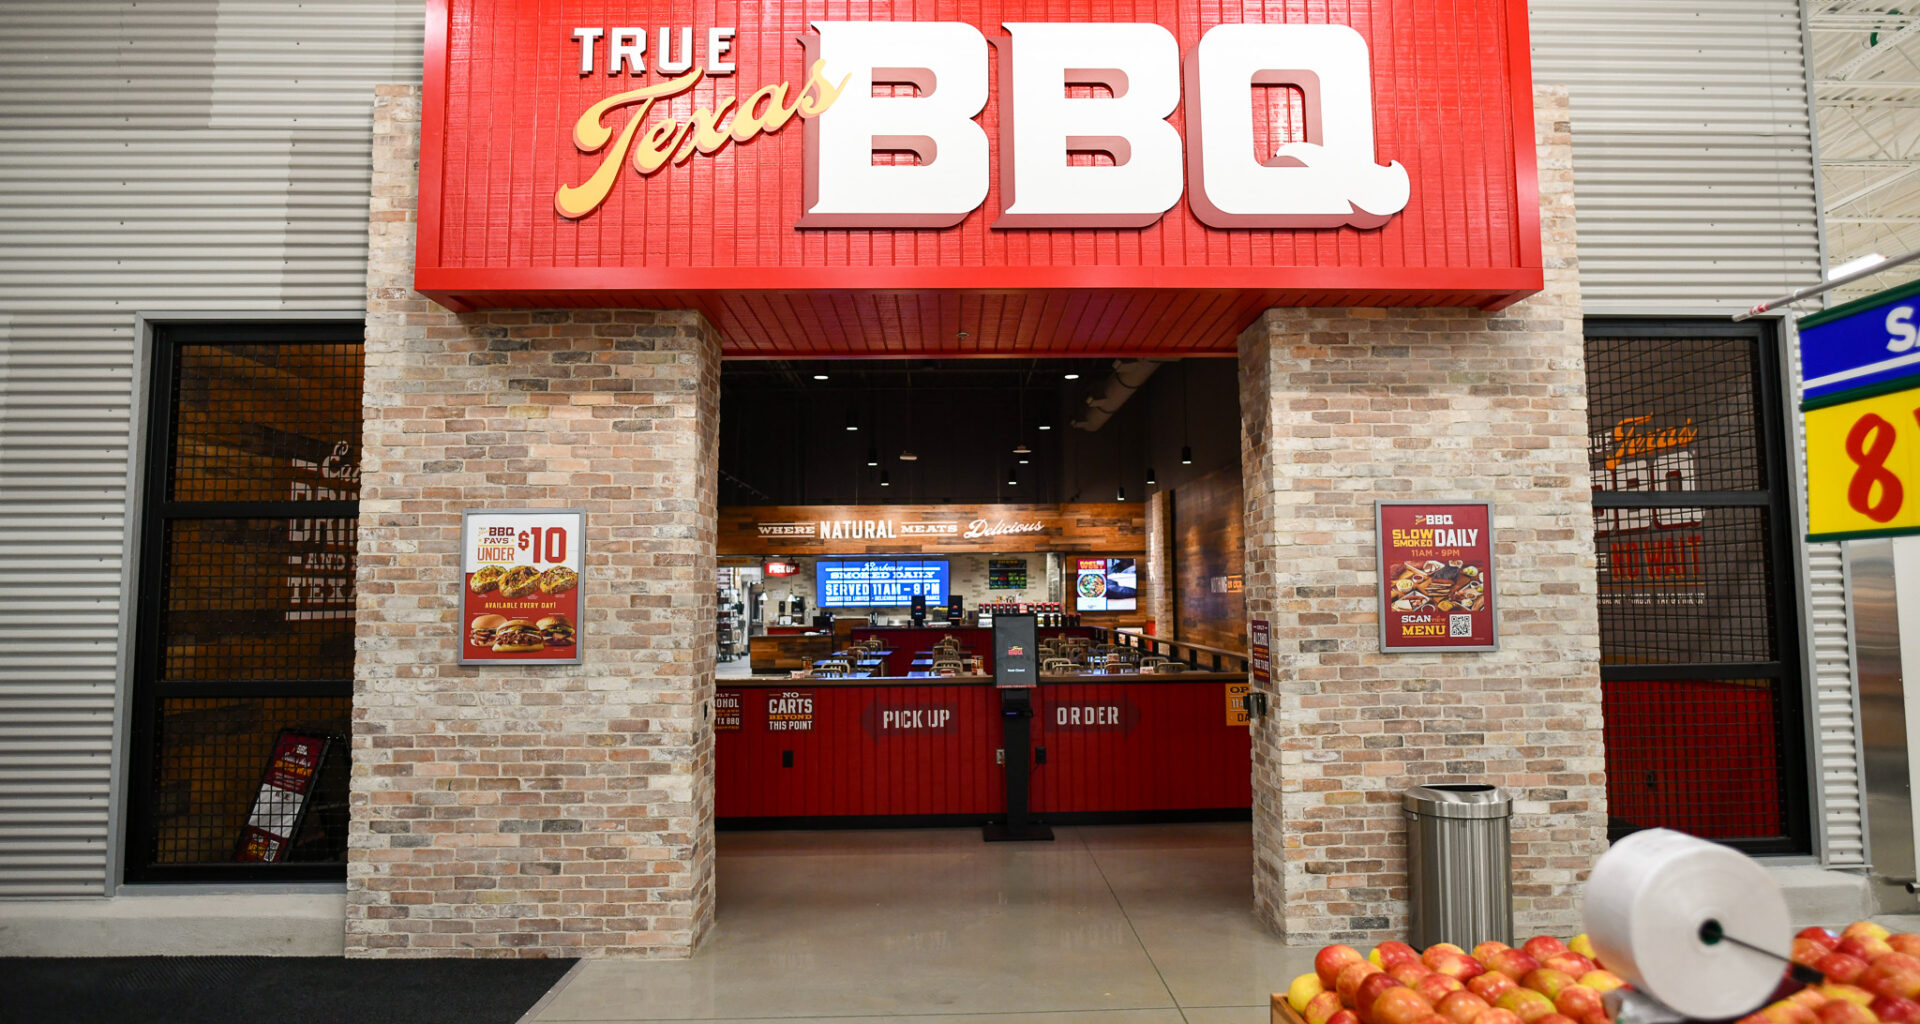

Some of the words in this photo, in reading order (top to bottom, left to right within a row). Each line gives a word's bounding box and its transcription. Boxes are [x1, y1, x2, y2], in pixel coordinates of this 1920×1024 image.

[571, 27, 736, 76] TRUE
[797, 21, 1410, 229] BBQ
[555, 59, 852, 219] Texas
[1885, 306, 1920, 352] S
[1605, 410, 1698, 470] Texas
[1845, 413, 1904, 524] 8
[1426, 514, 1454, 525] BBQ
[489, 527, 515, 536] BBQ
[758, 526, 815, 535] WHERE
[820, 520, 896, 539] NATURAL
[901, 524, 958, 534] MEATS
[964, 519, 1045, 539] Delicious
[1392, 529, 1434, 540] SLOW
[1434, 529, 1478, 547] DAILY
[478, 547, 514, 561] UNDER
[518, 526, 567, 564] $10
[305, 553, 346, 571] AND
[1611, 541, 1640, 580] NO
[1643, 536, 1701, 579] WAIT
[769, 564, 786, 573] PICK
[786, 564, 796, 573] UP
[893, 571, 936, 579] DAILY
[826, 583, 869, 596] SERVED
[872, 583, 900, 595] 11AM
[924, 583, 940, 595] PM
[1402, 625, 1446, 635] MENU
[768, 699, 813, 714] CARTS
[769, 721, 787, 730] THIS
[788, 720, 812, 730] POINT
[883, 710, 923, 729] PICK
[928, 709, 950, 728] UP
[1057, 707, 1119, 725] ORDER
